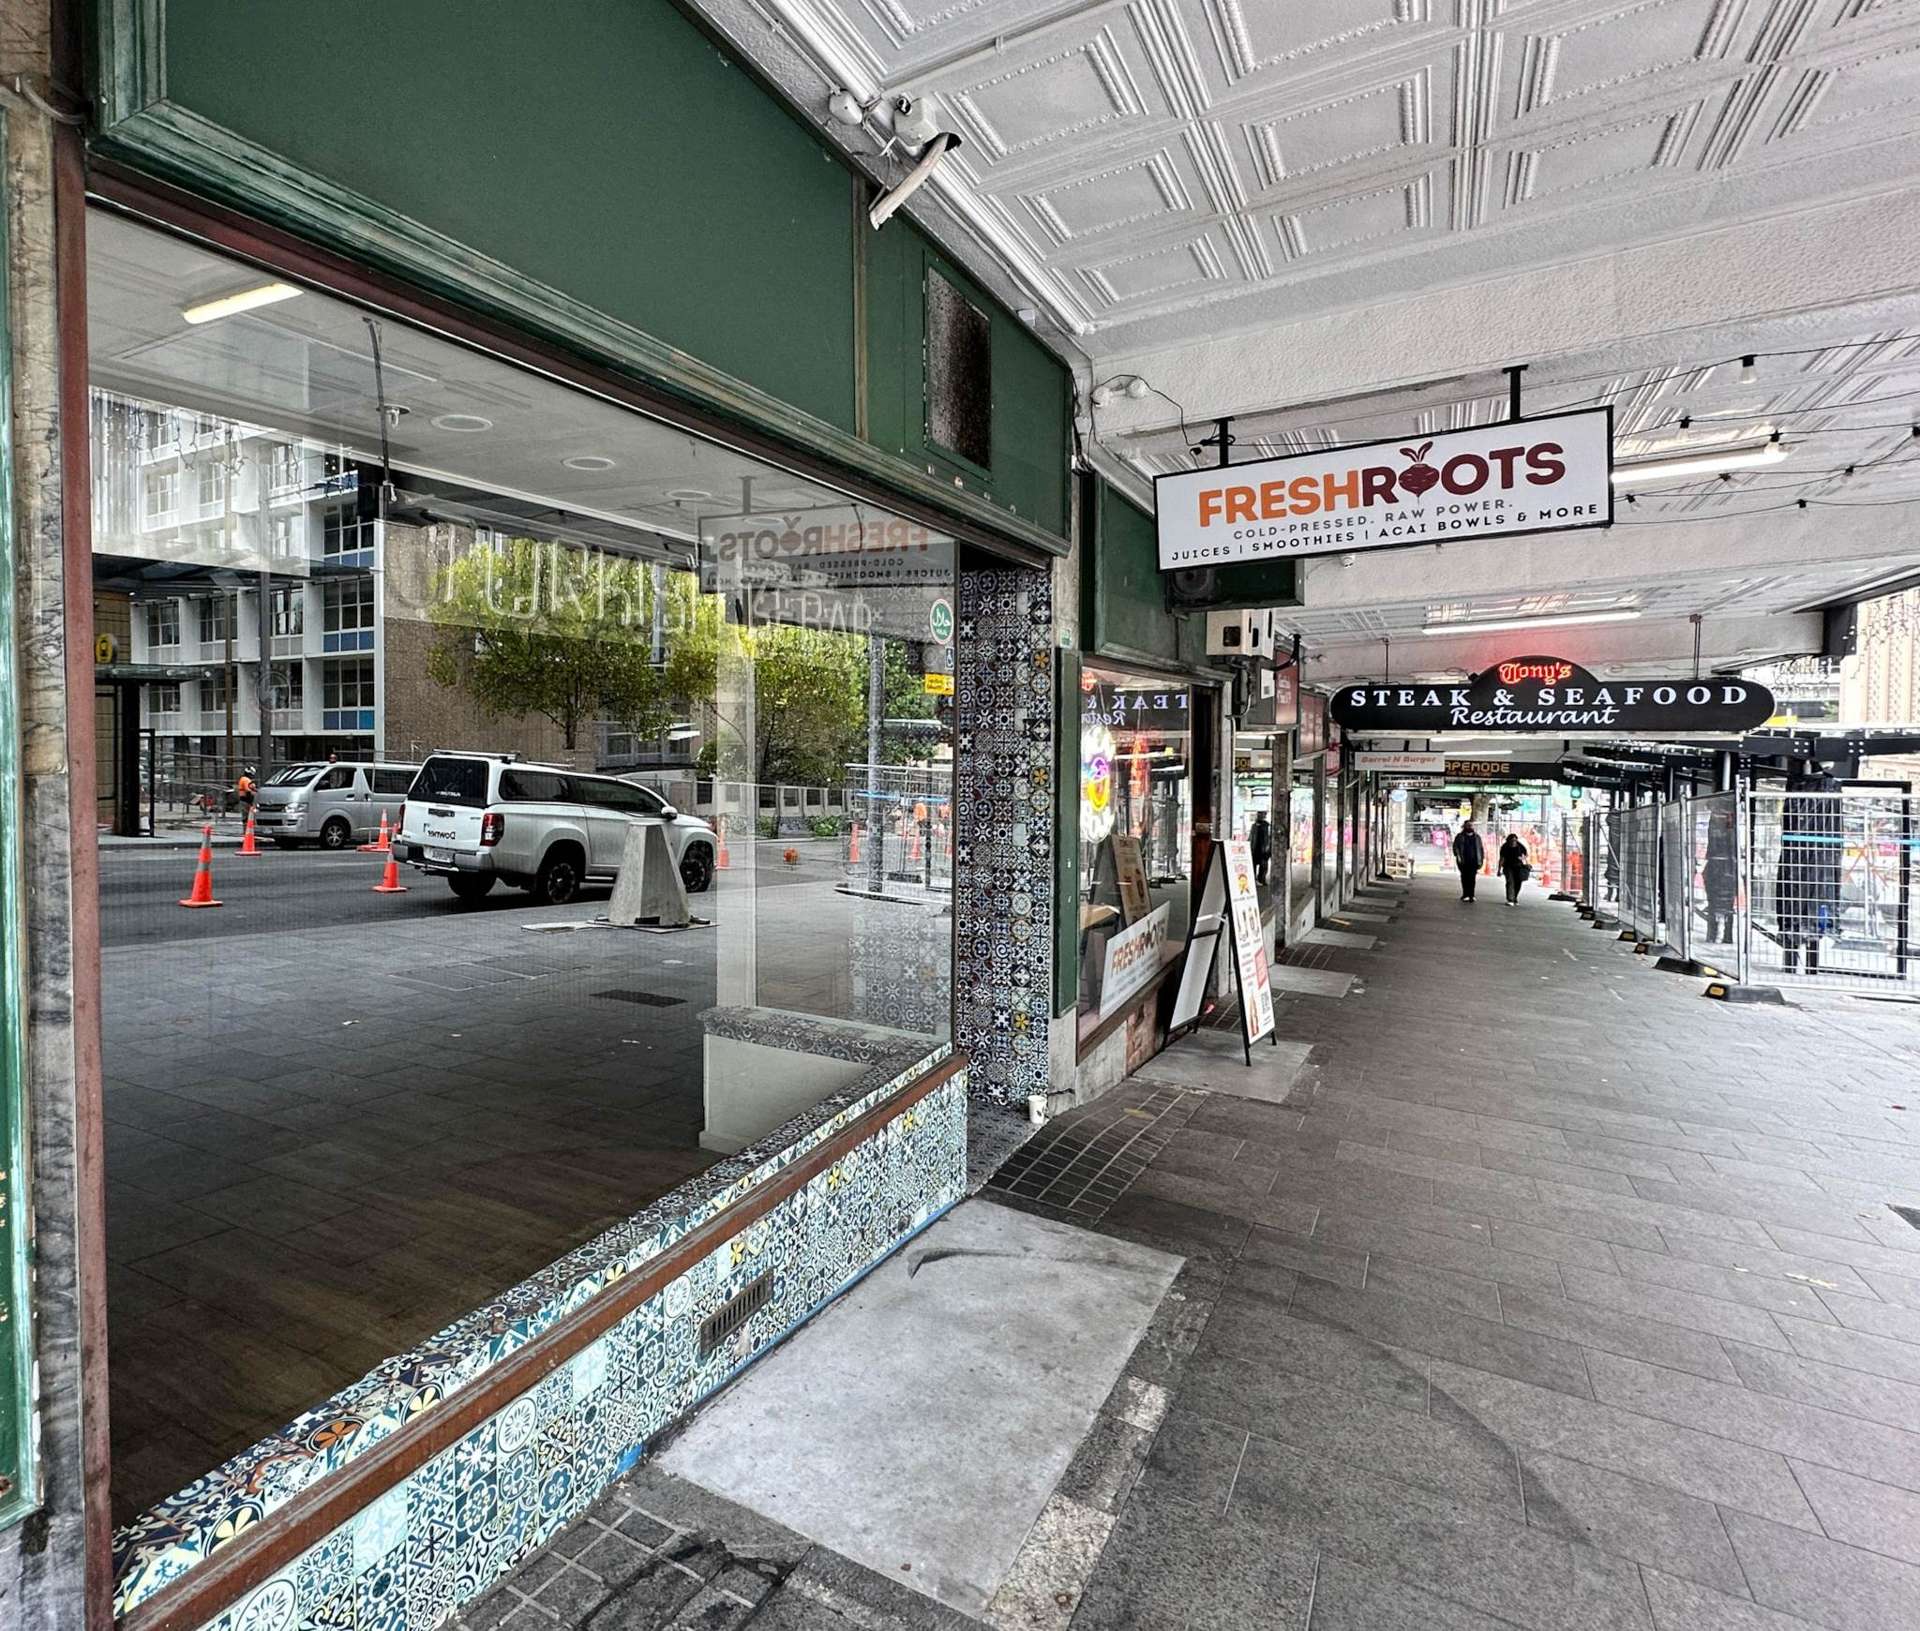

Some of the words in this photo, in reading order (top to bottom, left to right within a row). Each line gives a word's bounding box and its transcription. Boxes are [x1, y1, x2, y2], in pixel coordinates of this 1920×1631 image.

[1233, 515, 1374, 540] COLD-PRESSED.
[1385, 507, 1426, 523] RAW
[1436, 500, 1513, 517] POWER.
[1171, 545, 1231, 561] JUICES
[1251, 530, 1356, 553] SMOOTHIES
[1379, 523, 1428, 538] ACAI
[1438, 514, 1506, 531] BOWLS
[1517, 512, 1528, 522] &
[1539, 503, 1599, 519] MORE
[1499, 663, 1572, 685] Tony's
[1351, 688, 1472, 707] STEAK
[1493, 687, 1514, 706] &
[1538, 686, 1748, 706] SEAFOOD
[1451, 706, 1619, 726] Restaurant
